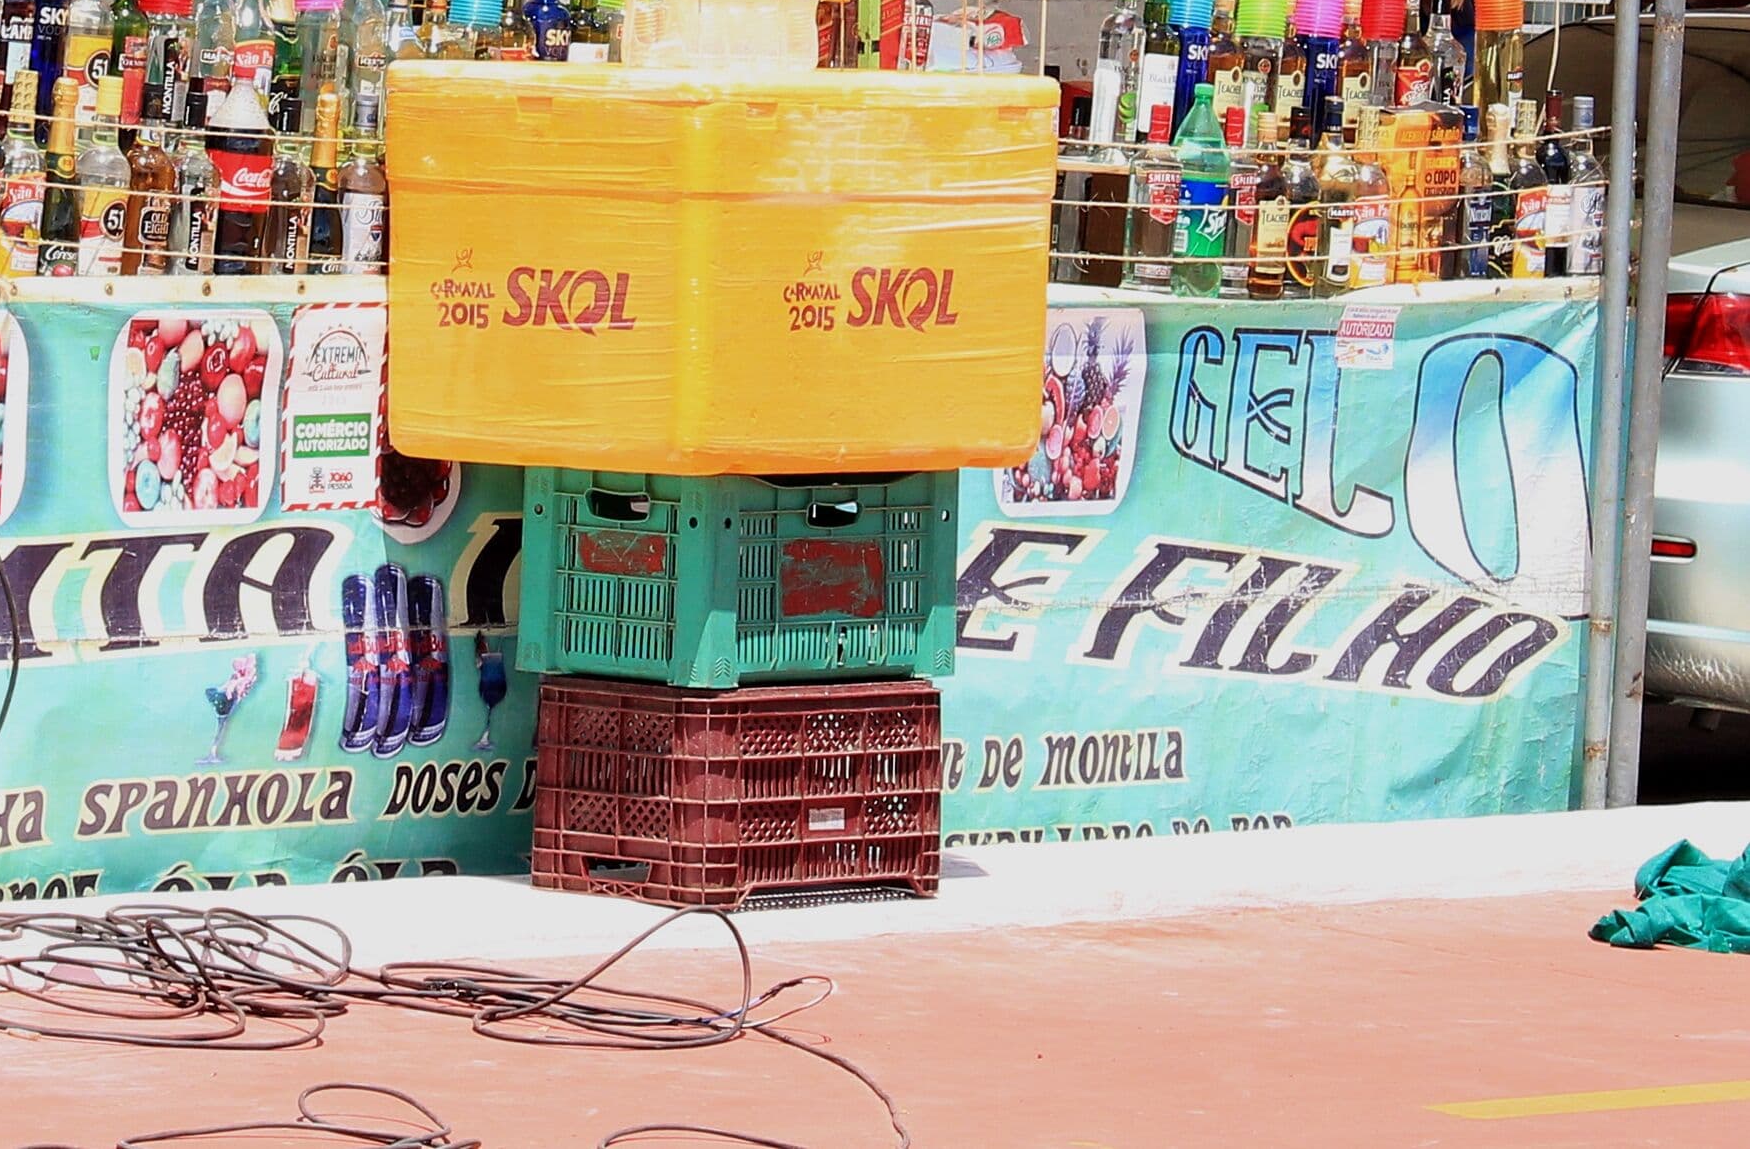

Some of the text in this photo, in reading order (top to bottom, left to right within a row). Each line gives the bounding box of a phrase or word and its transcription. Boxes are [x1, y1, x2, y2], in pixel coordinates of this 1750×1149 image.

[91, 57, 109, 80] 51
[162, 61, 176, 115] MONTILLA
[1433, 170, 1457, 185] COPO
[107, 210, 124, 231] 51
[143, 221, 171, 235] EIGHT
[151, 212, 168, 223] OLD
[188, 211, 203, 265] MONTILLA
[285, 216, 299, 270] MONTILLA
[430, 265, 638, 337] CARNATAL SKOL
[783, 266, 959, 334] CARNATAL SKOL
[437, 302, 490, 330] 2015
[789, 305, 836, 332] 2015
[1339, 321, 1393, 338] AUTORIZADO
[294, 419, 369, 439] COMÉRCIO
[294, 437, 369, 452] AUTORIZADO
[1168, 325, 1593, 618] GELO
[1083, 542, 1559, 698] FILHO
